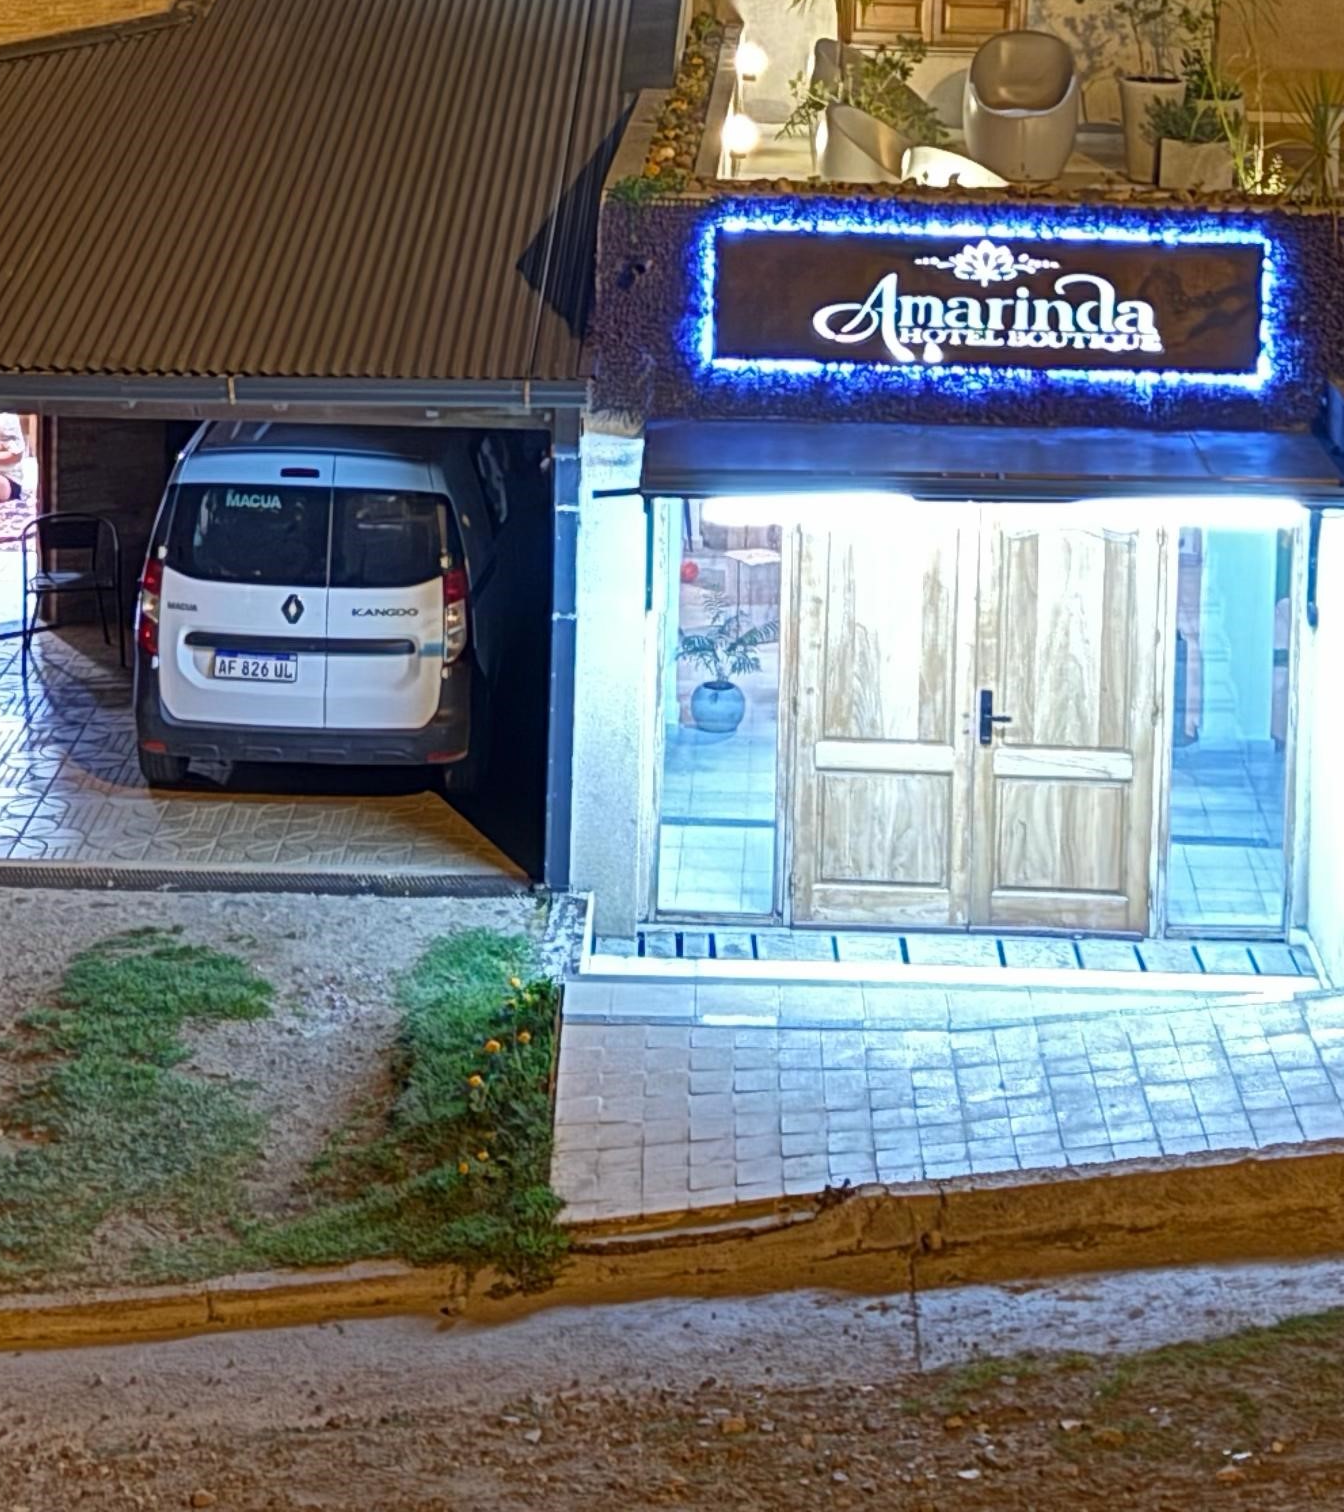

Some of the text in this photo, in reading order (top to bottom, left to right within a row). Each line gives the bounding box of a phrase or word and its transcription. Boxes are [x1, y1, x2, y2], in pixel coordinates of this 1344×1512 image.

[812, 272, 1159, 363] Amarinda
[900, 327, 1164, 353] HOTEL BOUTIQUE
[351, 608, 419, 617] KANGOO
[218, 659, 293, 678] AF 826 UL
